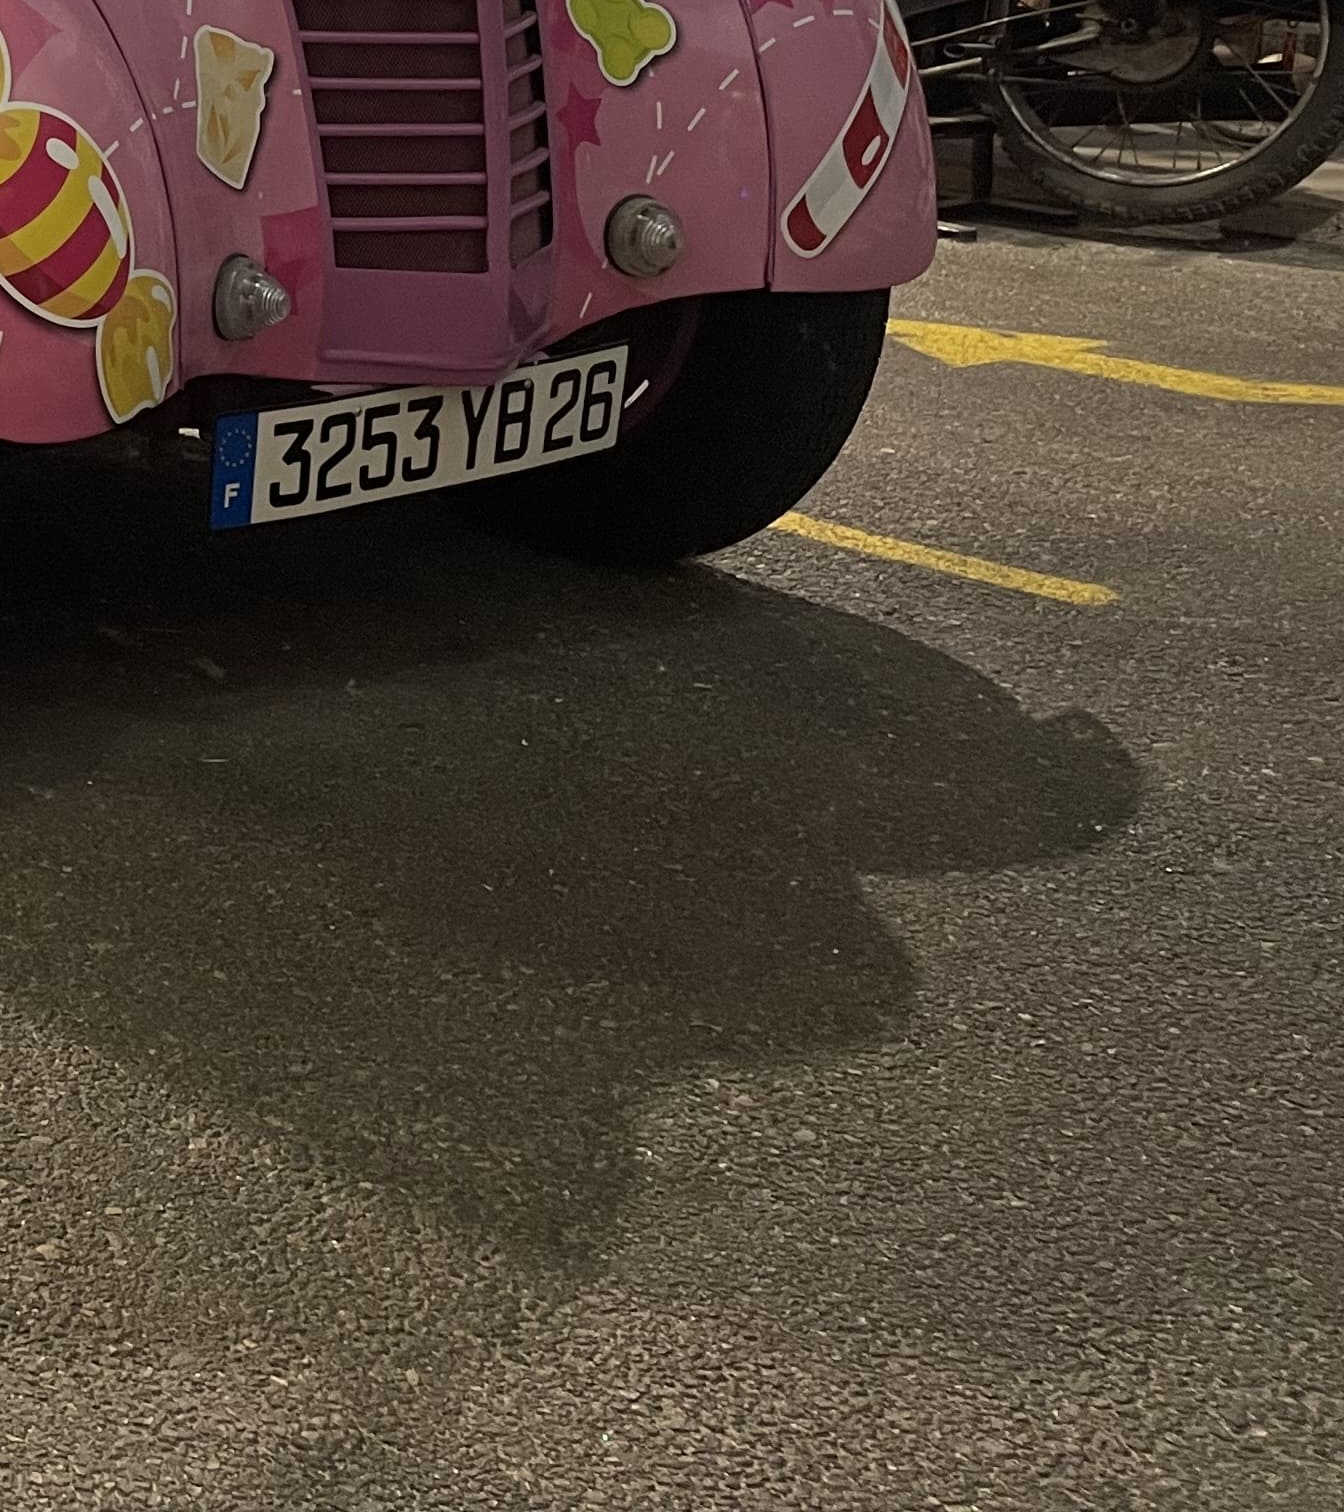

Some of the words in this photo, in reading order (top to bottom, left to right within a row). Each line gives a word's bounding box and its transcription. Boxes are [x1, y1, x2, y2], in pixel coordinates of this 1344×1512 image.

[222, 482, 240, 509] F
[268, 394, 444, 510] 3253
[462, 379, 534, 470] YB
[542, 359, 617, 454] 26
